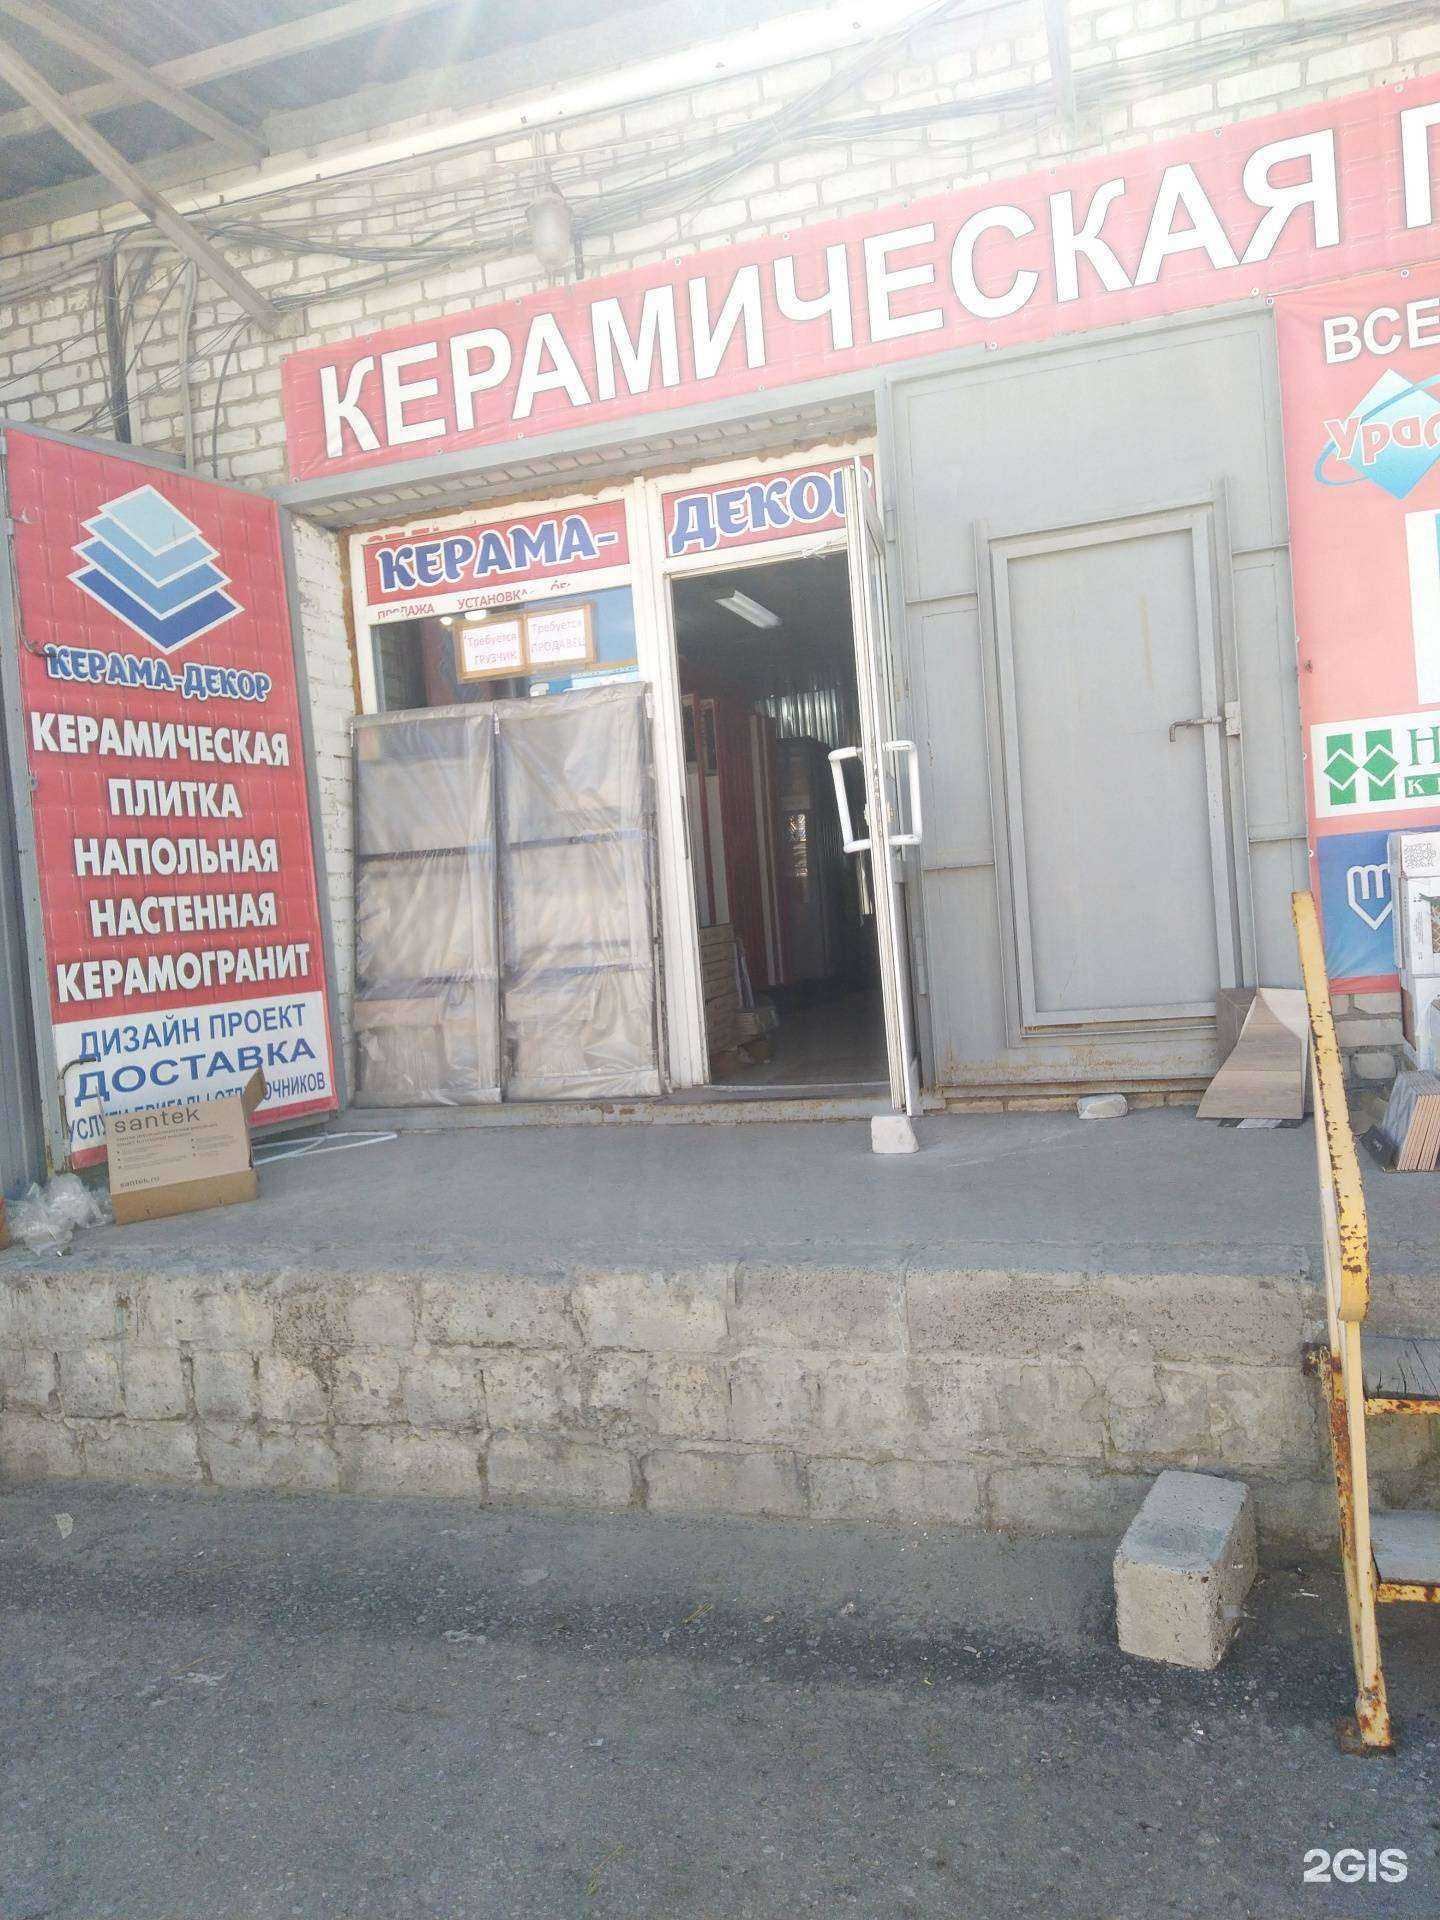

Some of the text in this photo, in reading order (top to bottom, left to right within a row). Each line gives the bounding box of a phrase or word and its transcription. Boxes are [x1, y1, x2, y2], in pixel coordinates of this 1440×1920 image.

[321, 127, 1340, 459] КЕРАМИЧЕСКАЯ
[43, 643, 272, 701] КЕРАМА-ДЕКОР
[30, 711, 290, 766] КЕРАМИЧЕСКАЯ
[107, 777, 243, 819] ПЛИТКА
[73, 837, 279, 877] НАПОЛЬНАЯ
[89, 892, 277, 937] НАСТЕННАЯ
[56, 943, 310, 1003] КЕРАМОГРАНИТ
[79, 1003, 307, 1062] ДИЗАЙН ПРОЕКТ
[74, 1037, 316, 1107] ДОСТАВКА
[114, 1107, 201, 1133] santek
